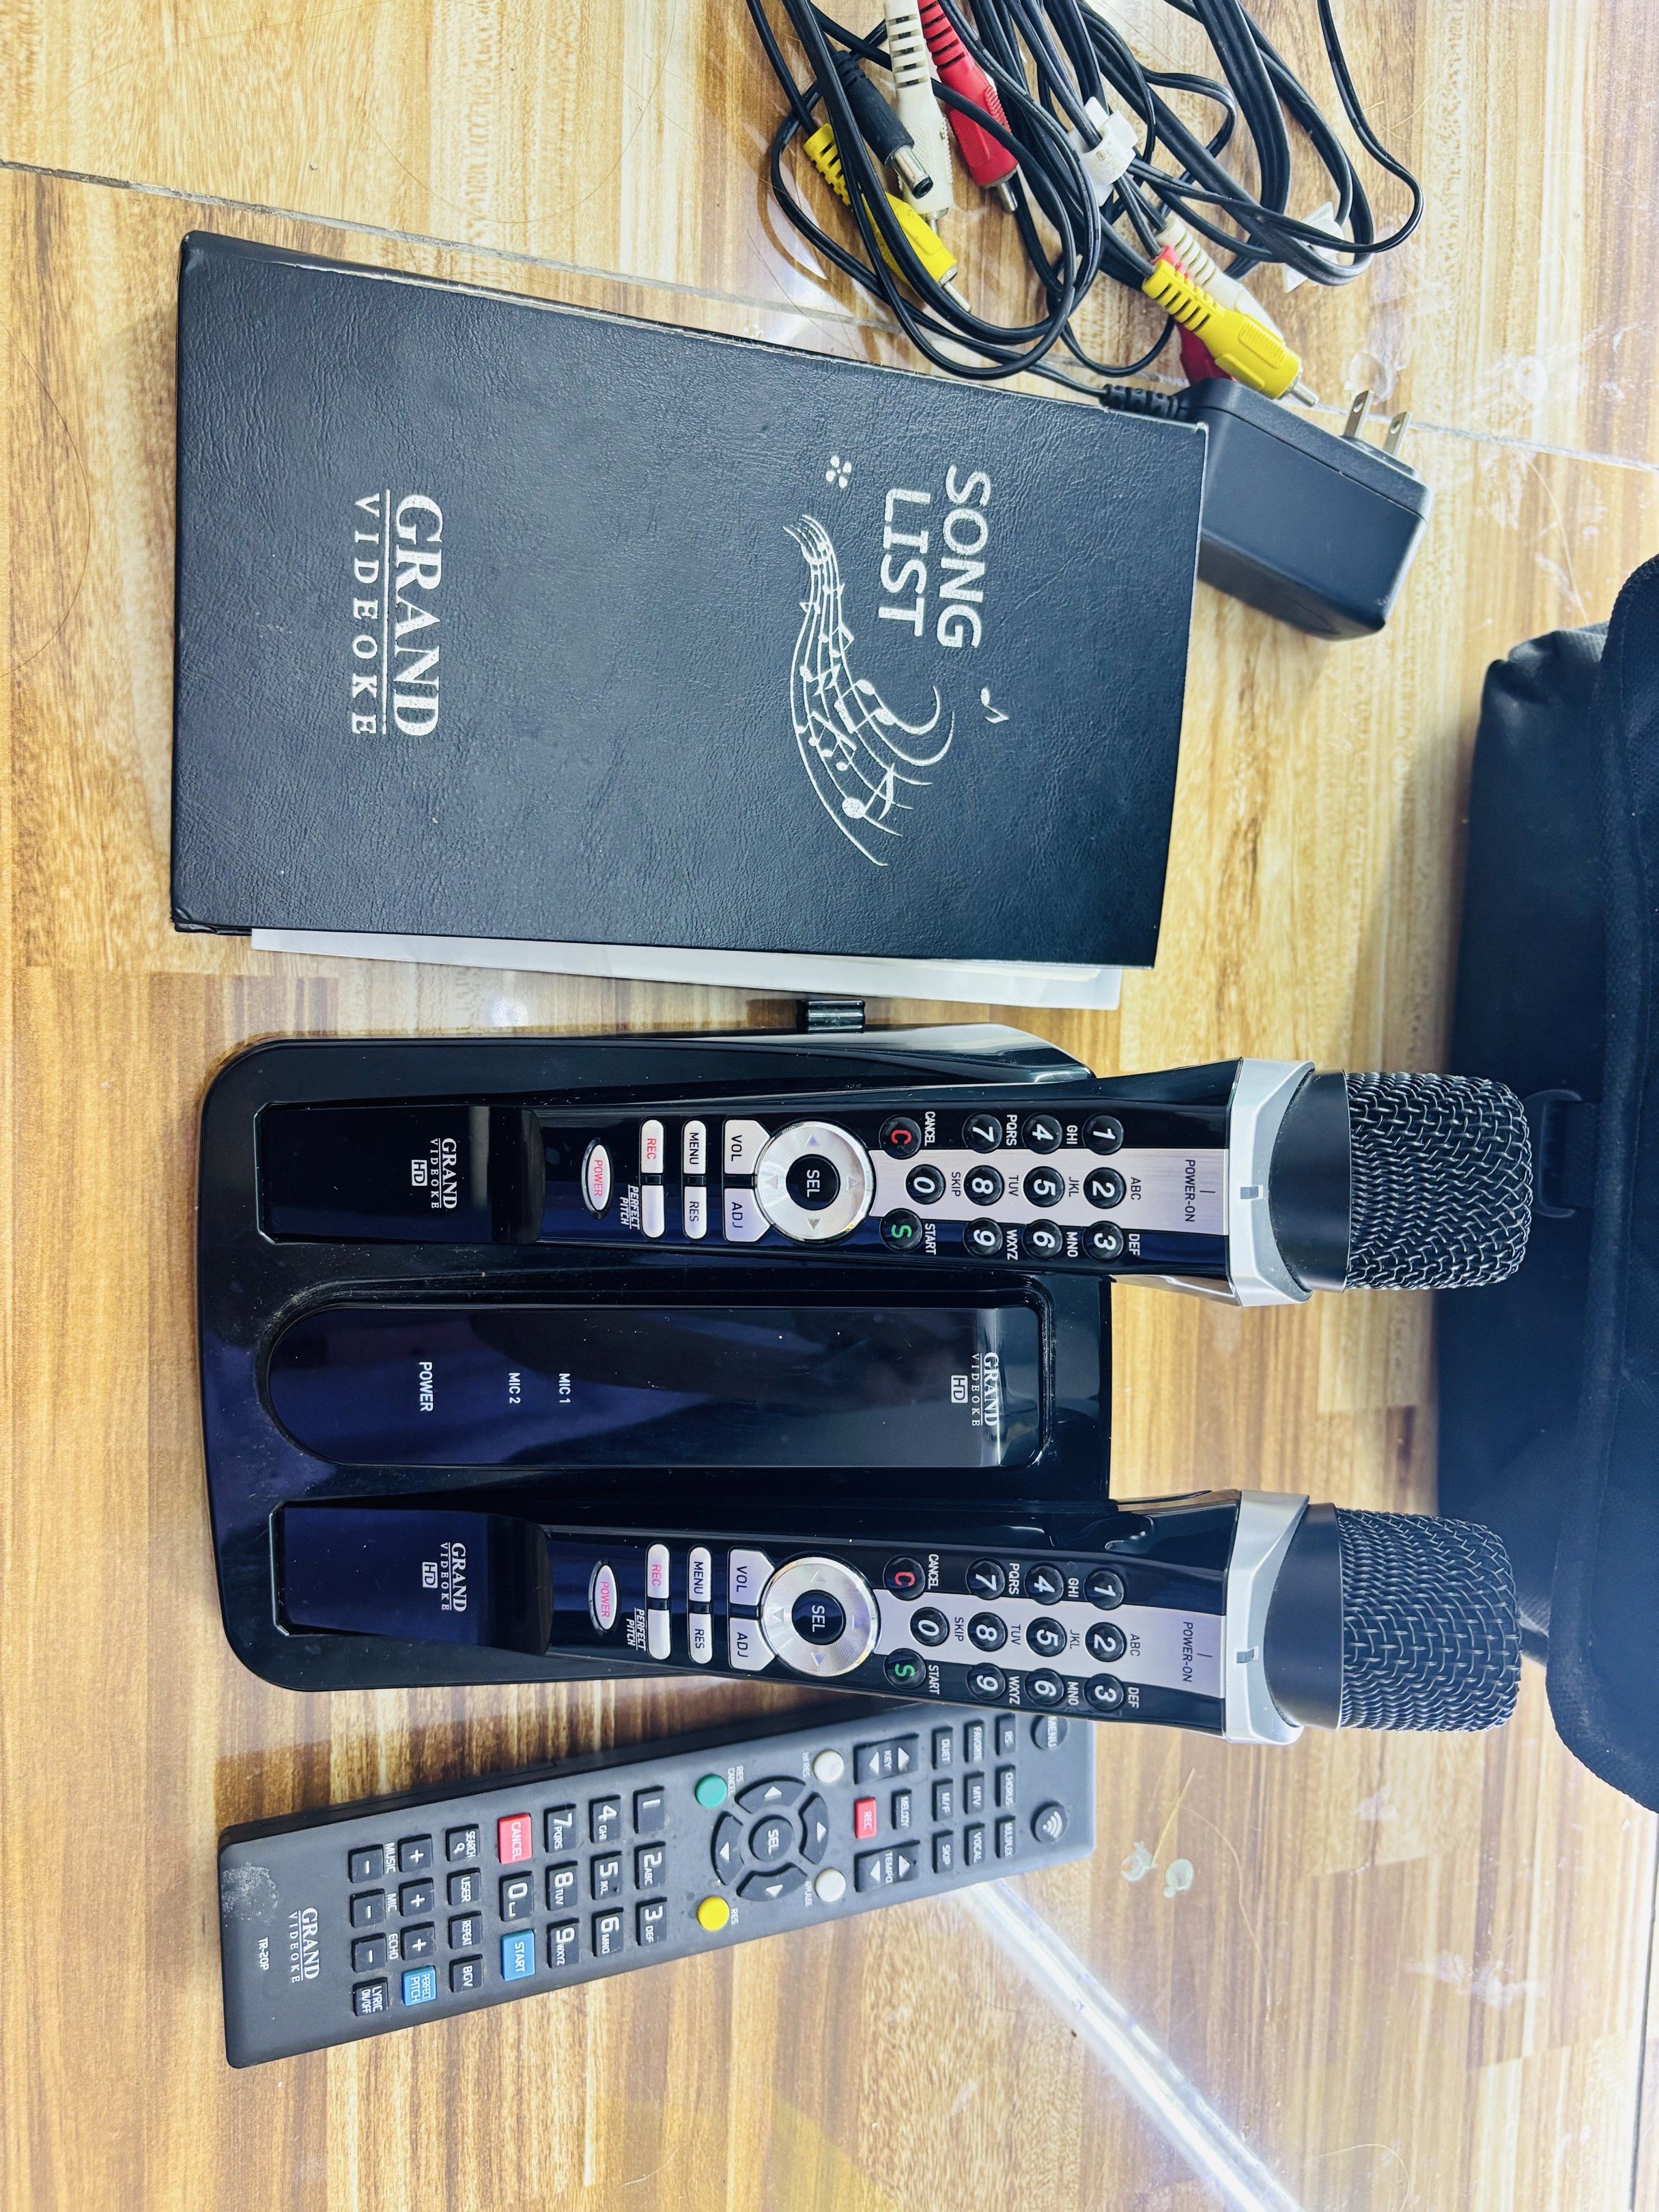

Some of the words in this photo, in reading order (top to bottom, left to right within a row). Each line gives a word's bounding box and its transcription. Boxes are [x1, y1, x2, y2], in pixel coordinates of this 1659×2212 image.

[878, 487, 930, 636] LIST
[935, 465, 992, 649] SONG
[352, 492, 381, 735] VIDEOKE
[392, 494, 443, 736] GRAND
[890, 1129, 912, 1145] C
[924, 1111, 935, 1146] CANCEL
[972, 1126, 994, 1142] 7
[1006, 1114, 1017, 1146] PQRS
[1032, 1124, 1053, 1140] 4
[1066, 1125, 1077, 1144] GHI
[1093, 1128, 1116, 1139] 1
[647, 1138, 657, 1159] REC
[690, 1132, 699, 1165] MENU
[731, 1135, 742, 1161] VOL
[413, 1161, 426, 1185] HD
[430, 1138, 439, 1208] VIDEOKE
[442, 1137, 457, 1208] GRAND
[594, 1159, 603, 1196] POWER
[807, 1169, 820, 1197] SEL
[951, 1172, 961, 1196] SKIP
[913, 1176, 935, 1193] 0
[972, 1178, 993, 1193] 8
[1008, 1175, 1019, 1196] TUV
[1034, 1179, 1055, 1195] 5
[1068, 1177, 1079, 1197] JKL
[1092, 1181, 1115, 1197] 2
[1131, 1177, 1141, 1200] ABC
[1185, 1160, 1195, 1221] POWER-ON
[620, 1197, 629, 1225] PITCH
[630, 1185, 640, 1230] PERFECT
[690, 1201, 699, 1221] RES
[732, 1202, 743, 1228] ADJ
[891, 1224, 912, 1238] S
[925, 1223, 936, 1255] START
[974, 1230, 995, 1246] 9
[1033, 1231, 1054, 1248] 6
[1094, 1233, 1116, 1250] 3
[1006, 1230, 1018, 1260] WXYZ
[1066, 1232, 1078, 1257] MNO
[1129, 1234, 1139, 1256] DEF
[419, 1361, 434, 1411] POWER
[509, 1372, 520, 1394] MIC
[558, 1373, 571, 1395] MIC
[953, 1376, 966, 1401] HD
[972, 1353, 980, 1426] VIDEOKE
[984, 1352, 999, 1426] GRAND
[424, 1563, 436, 1587] HD
[440, 1542, 449, 1611] VIDEOKE
[451, 1542, 466, 1612] GRAND
[652, 1564, 662, 1586] REC
[694, 1561, 703, 1594] MENU
[737, 1565, 748, 1592] VOL
[894, 1572, 916, 1587] C
[928, 1554, 939, 1589] CANCEL
[975, 1574, 997, 1591] 7
[1008, 1563, 1019, 1595] PQRS
[1034, 1575, 1055, 1593] 4
[1067, 1578, 1079, 1598] GHI
[1094, 1584, 1116, 1597] 1
[601, 1581, 610, 1617] POWER
[636, 1608, 646, 1651] PERFECT
[812, 1604, 825, 1632] SEL
[918, 1619, 939, 1636] 0
[954, 1617, 964, 1641] SKIP
[626, 1619, 636, 1647] PITCH
[695, 1628, 705, 1649] RES
[976, 1624, 998, 1641] 8
[1010, 1624, 1021, 1645] TUV
[1036, 1629, 1058, 1645] 5
[1069, 1629, 1080, 1649] JKL
[1094, 1634, 1116, 1651] 2
[737, 1632, 748, 1658] ADJ
[1130, 1634, 1140, 1656] ABC
[1182, 1621, 1193, 1682] POWER-ON
[894, 1663, 915, 1677] S
[928, 1664, 939, 1695] START
[976, 1675, 999, 1691] 9
[1009, 1676, 1020, 1705] WXYZ
[1035, 1679, 1056, 1697] 6
[1068, 1682, 1079, 1705] MNO
[1094, 1685, 1116, 1703] 3
[1128, 1687, 1139, 1708] DEF
[1047, 1716, 1058, 1748] MENU
[941, 1738, 951, 1763] DUET
[973, 1727, 982, 1761] FAVORITE
[802, 1762, 810, 1778] RES
[883, 1750, 892, 1770] KEY
[728, 1768, 736, 1796] CANCEL
[736, 1766, 744, 1781] RES
[972, 1786, 982, 1806] MTV
[1005, 1772, 1015, 1807] CHORUS
[599, 1805, 617, 1820] 4
[901, 1796, 909, 1827] MELODY
[941, 1792, 951, 1813] M/F
[554, 1813, 572, 1826] 7
[864, 1811, 873, 1830] REC
[465, 1830, 476, 1858] SEARCH
[511, 1821, 522, 1859] CANCEL
[554, 1826, 563, 1849] PQRS
[599, 1825, 608, 1841] GHI
[768, 1829, 780, 1855] SEL
[386, 1843, 395, 1873] MUSIC
[941, 1844, 951, 1865] SKIP
[973, 1832, 982, 1863] VOCAL
[599, 1862, 618, 1877] 5
[644, 1852, 662, 1867] 2
[885, 1852, 893, 1883] TEMPO
[554, 1872, 573, 1888] 8
[644, 1867, 653, 1885] ABC
[462, 1877, 470, 1902] USER
[509, 1883, 528, 1898] 0
[555, 1888, 564, 1905] TUV
[600, 1881, 608, 1895] JKL
[387, 1893, 397, 1912] MIC
[644, 1905, 663, 1920] 3
[601, 1916, 619, 1931] 6
[731, 1908, 739, 1925] RES
[302, 1908, 320, 1979] GRAND
[462, 1920, 472, 1945] REPEAT
[556, 1927, 574, 1943] 9
[601, 1934, 610, 1954] MNO
[645, 1925, 654, 1943] DEF
[259, 1937, 269, 1970] TR-20P
[289, 1912, 300, 1983] VIDEOKE
[389, 1933, 398, 1960] ECHO
[515, 1942, 525, 1972] START
[556, 1943, 565, 1966] WXYZ
[422, 1974, 430, 2000] PERFECT
[463, 1966, 473, 1987] BGV
[362, 1989, 371, 2013] ON/OFF
[373, 1986, 382, 2012] LYRIC
[410, 1976, 420, 2003] PITCH
